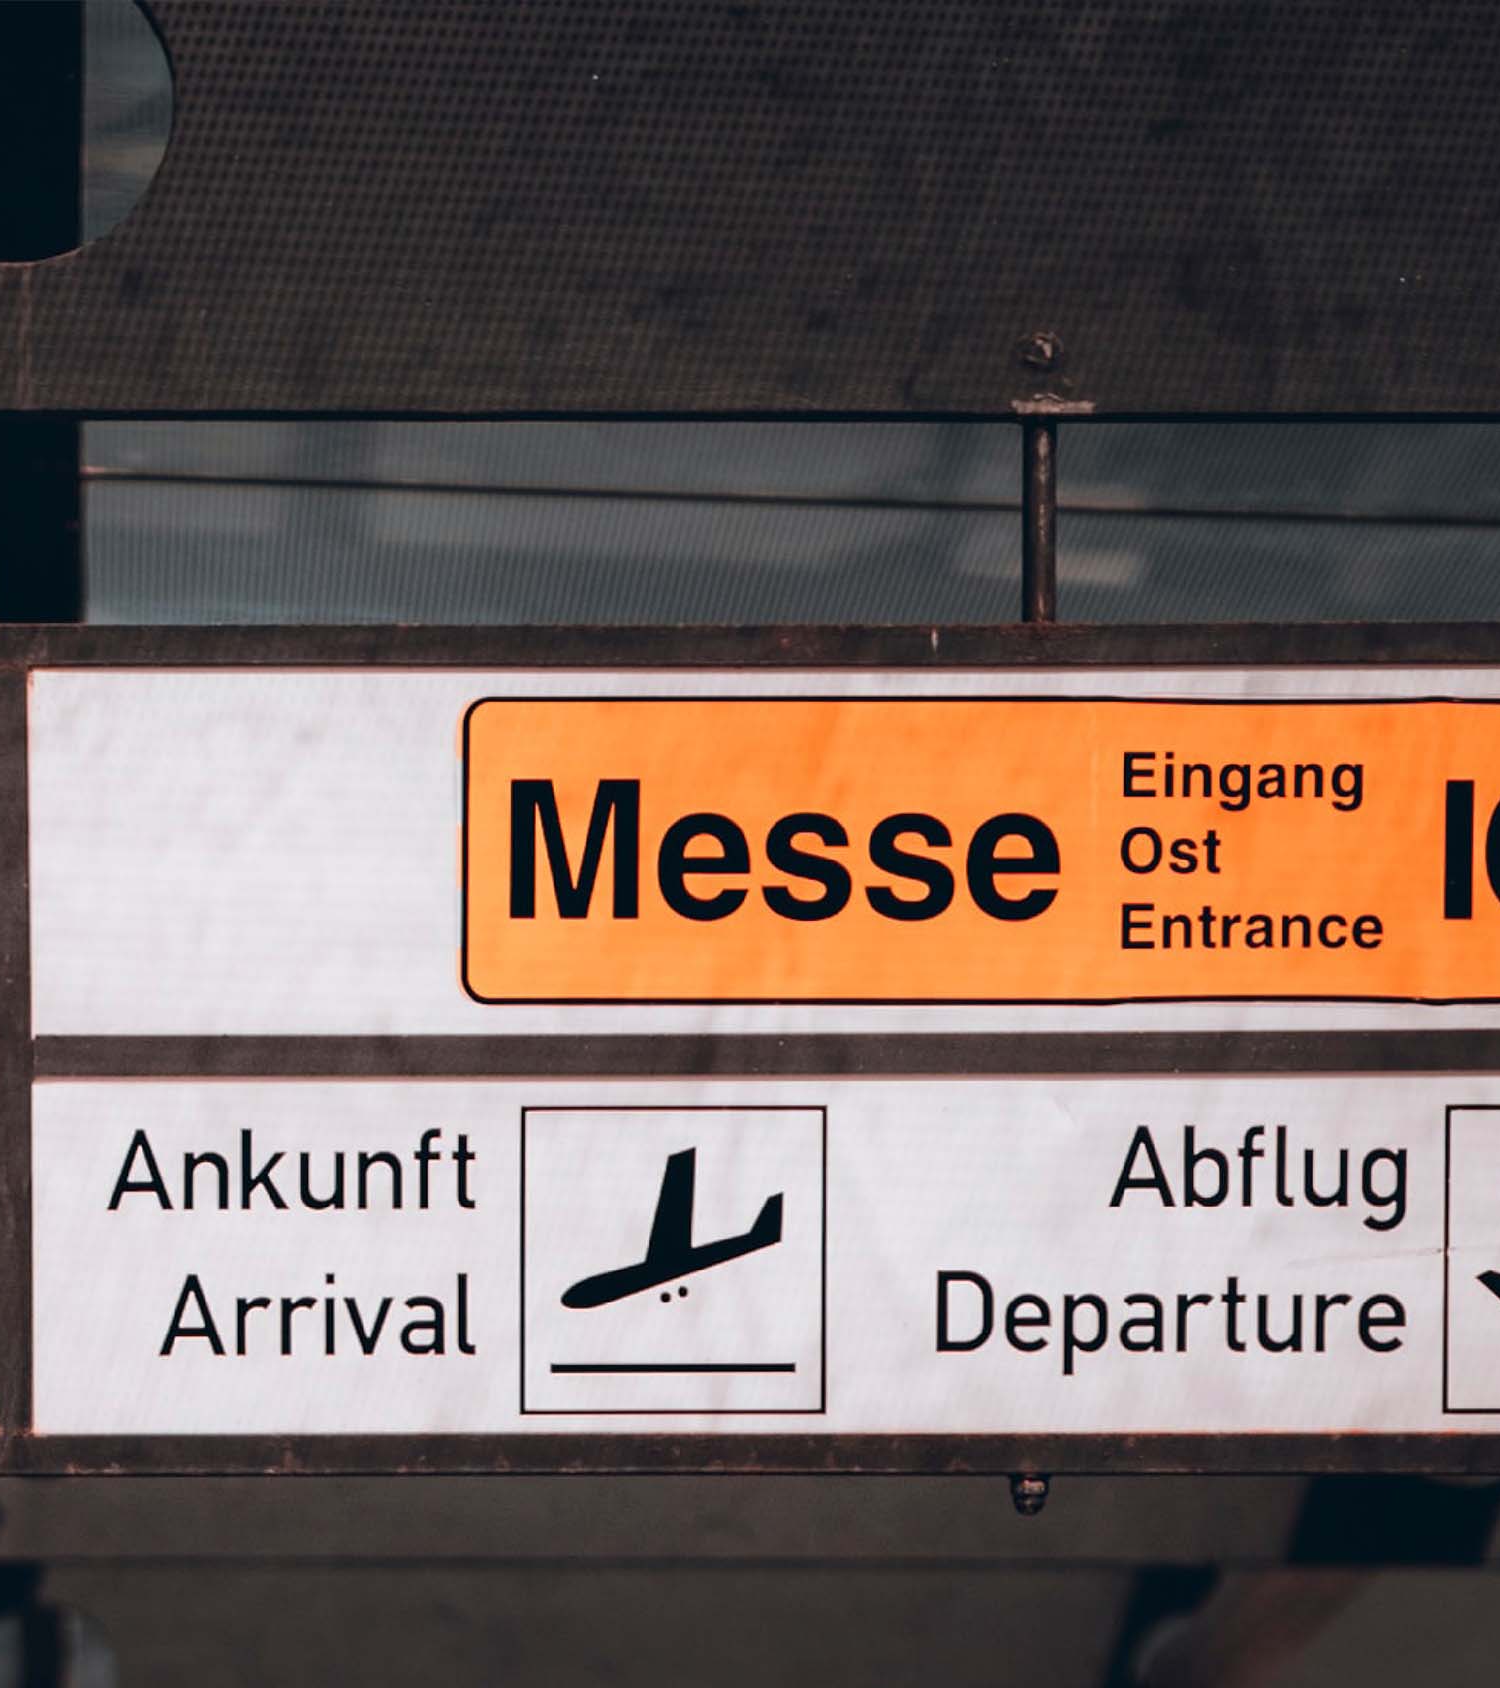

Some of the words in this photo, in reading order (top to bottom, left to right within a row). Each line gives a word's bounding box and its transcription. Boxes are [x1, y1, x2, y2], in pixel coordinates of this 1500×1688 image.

[1123, 752, 1364, 812] Eingang
[509, 778, 1061, 922] Messe
[1120, 826, 1221, 875] Ost
[1121, 902, 1384, 950] Entrance
[107, 1128, 476, 1211] Ankunft
[1108, 1124, 1408, 1232] Abflug
[159, 1272, 476, 1357] Arrival
[936, 1270, 1406, 1376] Departure
